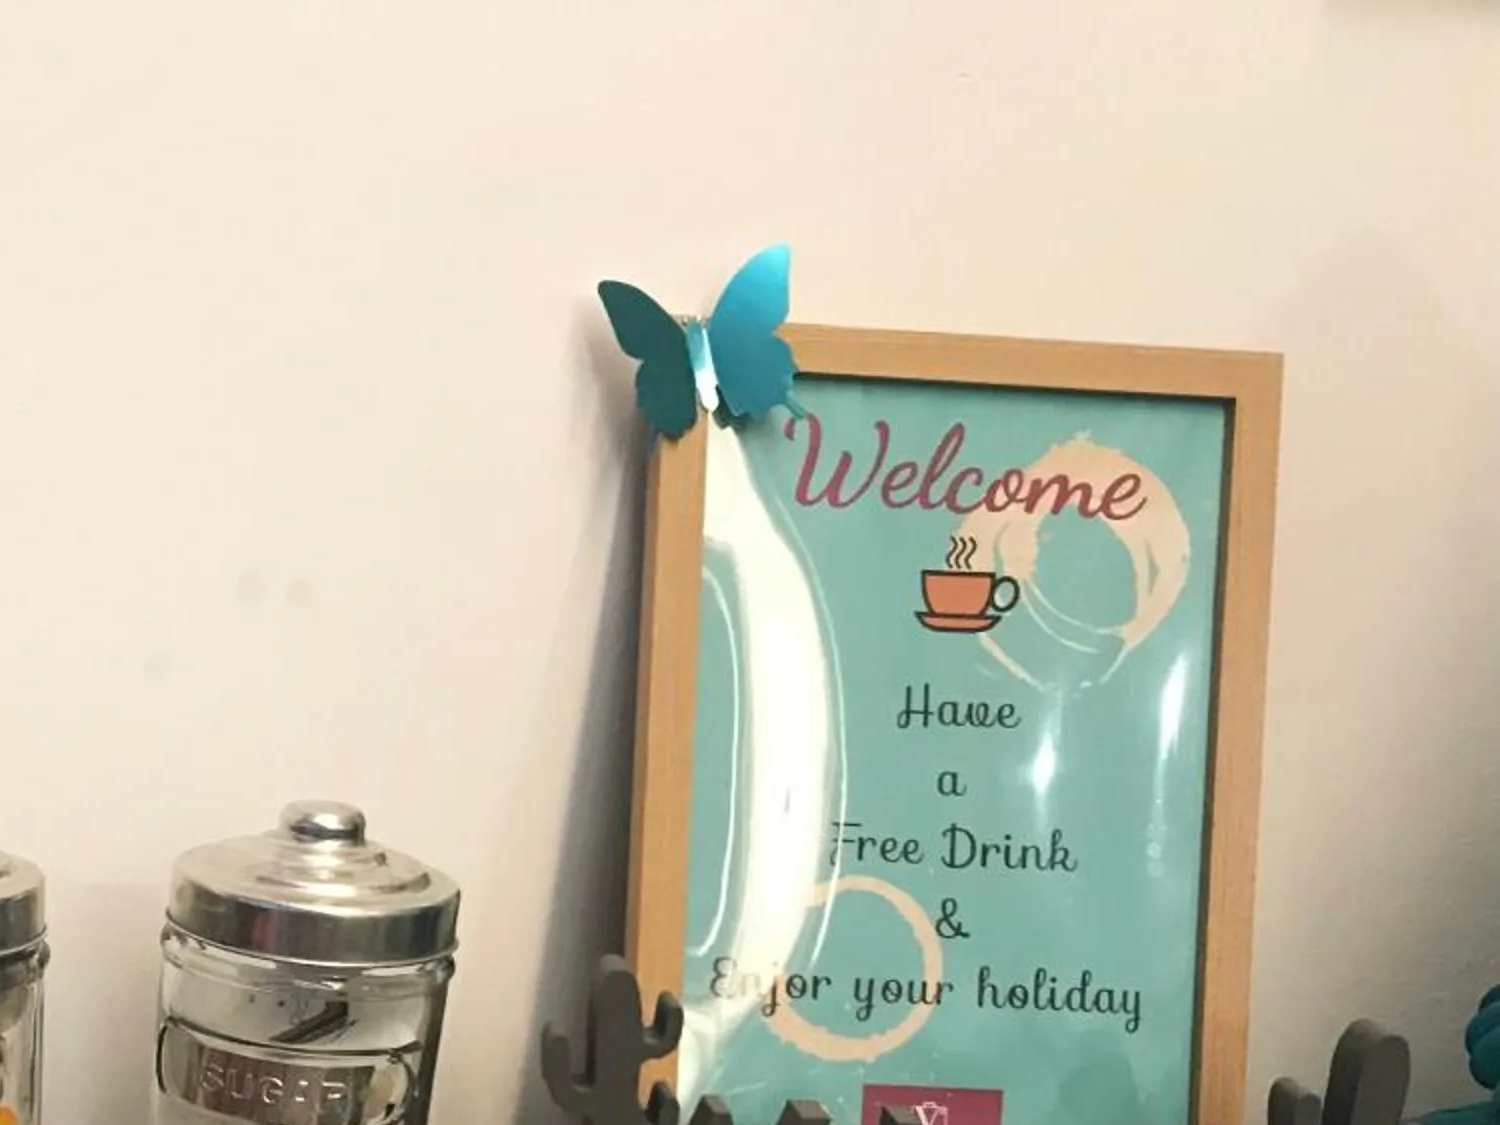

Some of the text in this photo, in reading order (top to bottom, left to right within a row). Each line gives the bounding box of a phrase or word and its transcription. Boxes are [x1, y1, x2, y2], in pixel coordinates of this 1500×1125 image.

[783, 412, 1148, 520] Welcome
[896, 683, 1023, 729] Have
[937, 770, 968, 797] a
[829, 821, 1078, 873] Free Drink
[935, 897, 971, 939] &
[853, 978, 955, 1022] your
[976, 966, 1142, 1034] holiday
